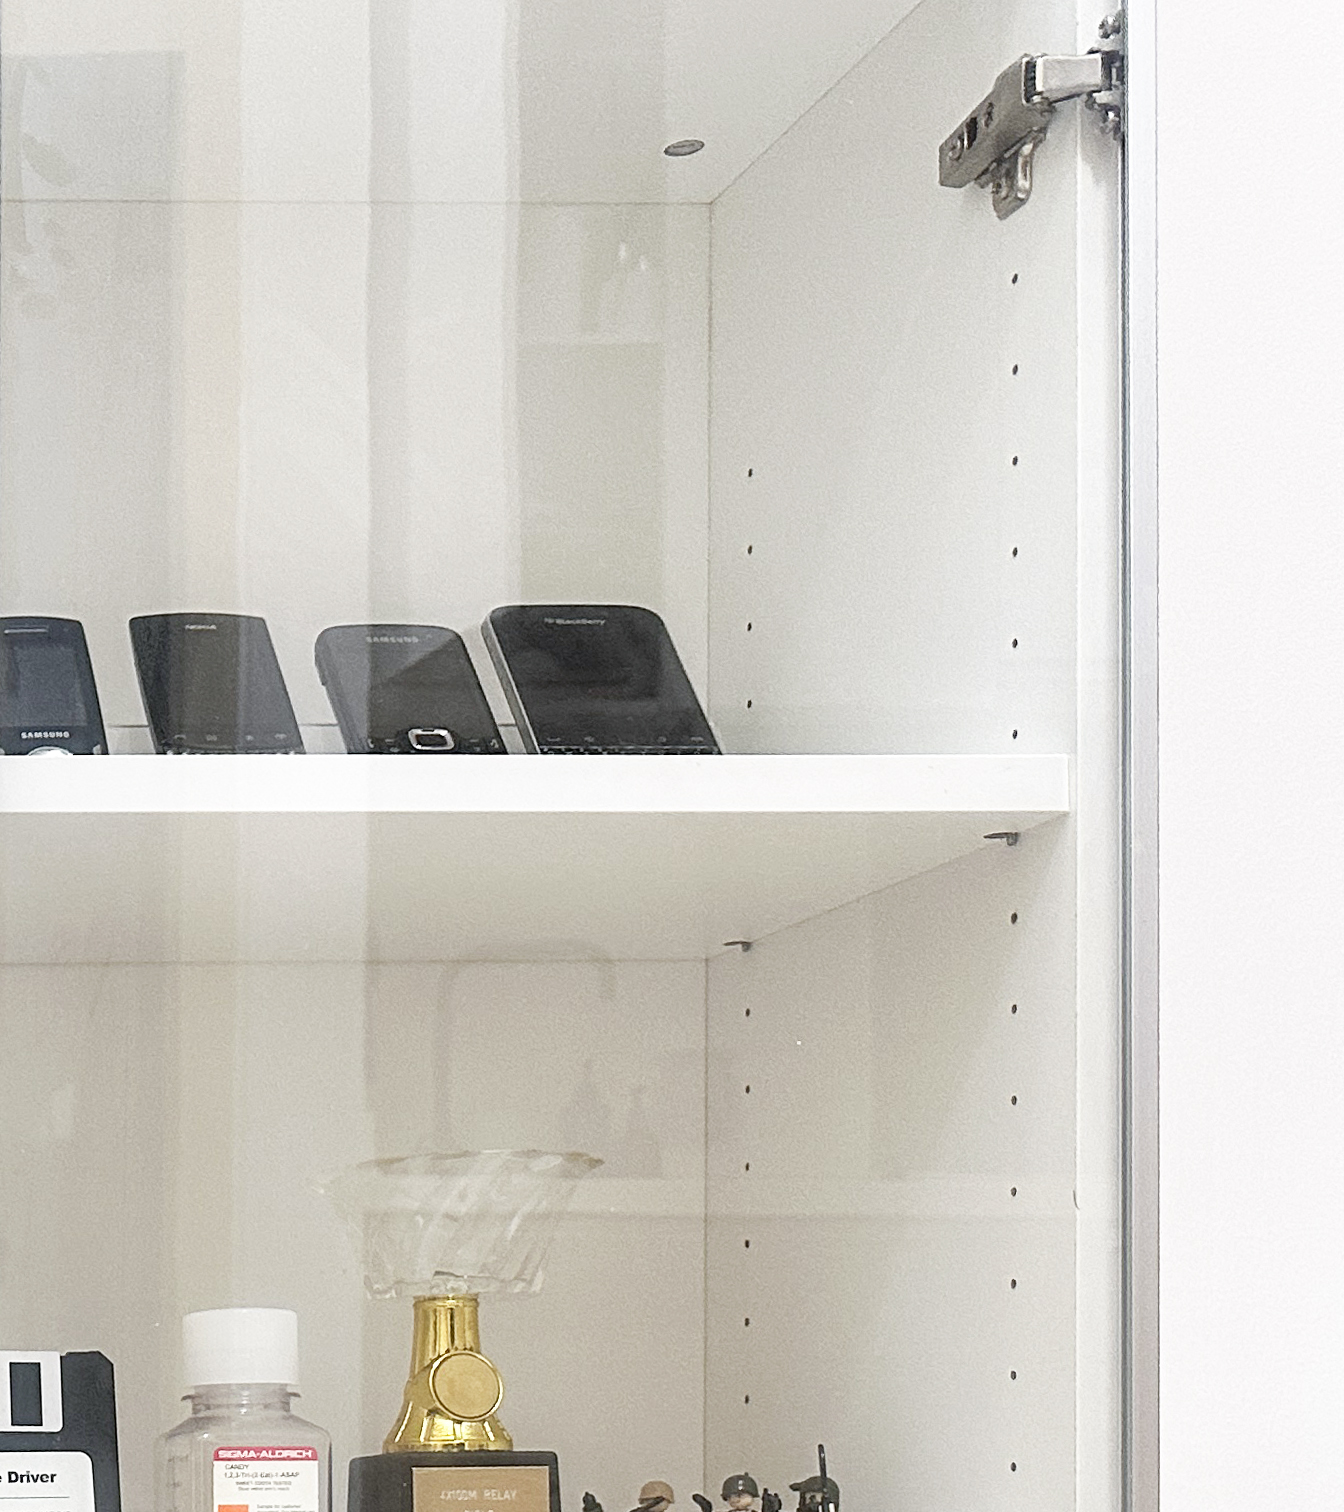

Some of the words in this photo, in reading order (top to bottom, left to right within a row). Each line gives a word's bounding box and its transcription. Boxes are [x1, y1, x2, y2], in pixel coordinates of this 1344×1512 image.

[366, 636, 420, 644] SAMSUNG
[21, 731, 70, 739] SAMSUNG
[7, 1470, 57, 1485] Driver
[483, 1488, 518, 1501] RELAY
